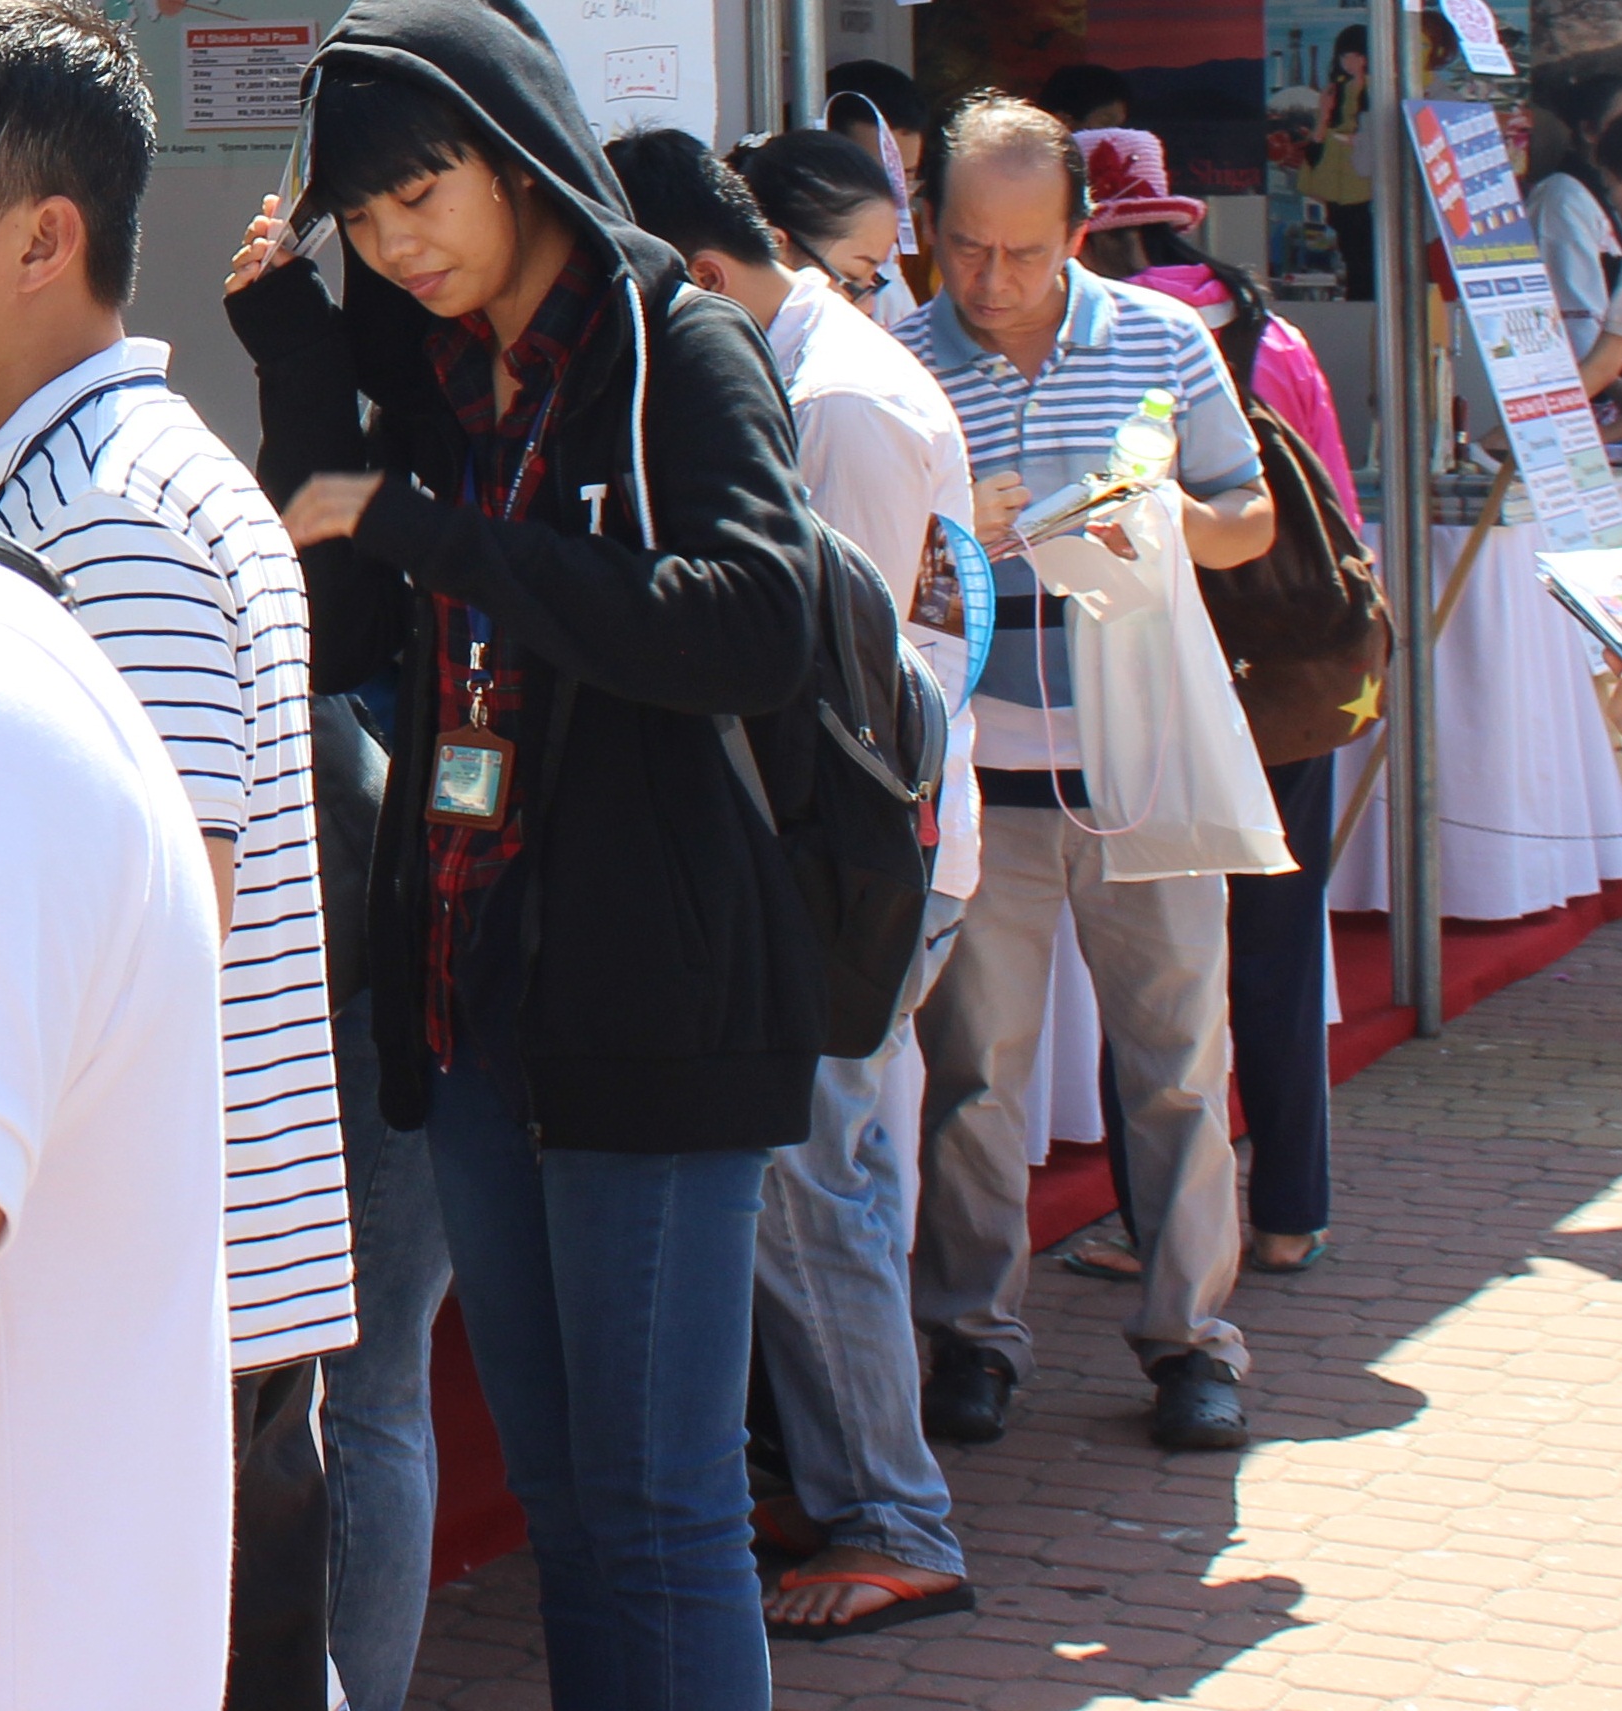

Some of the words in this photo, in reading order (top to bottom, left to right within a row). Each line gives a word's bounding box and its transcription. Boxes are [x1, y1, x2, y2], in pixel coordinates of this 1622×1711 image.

[207, 33, 248, 44] Shikoku
[250, 33, 271, 43] Rail
[272, 32, 298, 42] Pass
